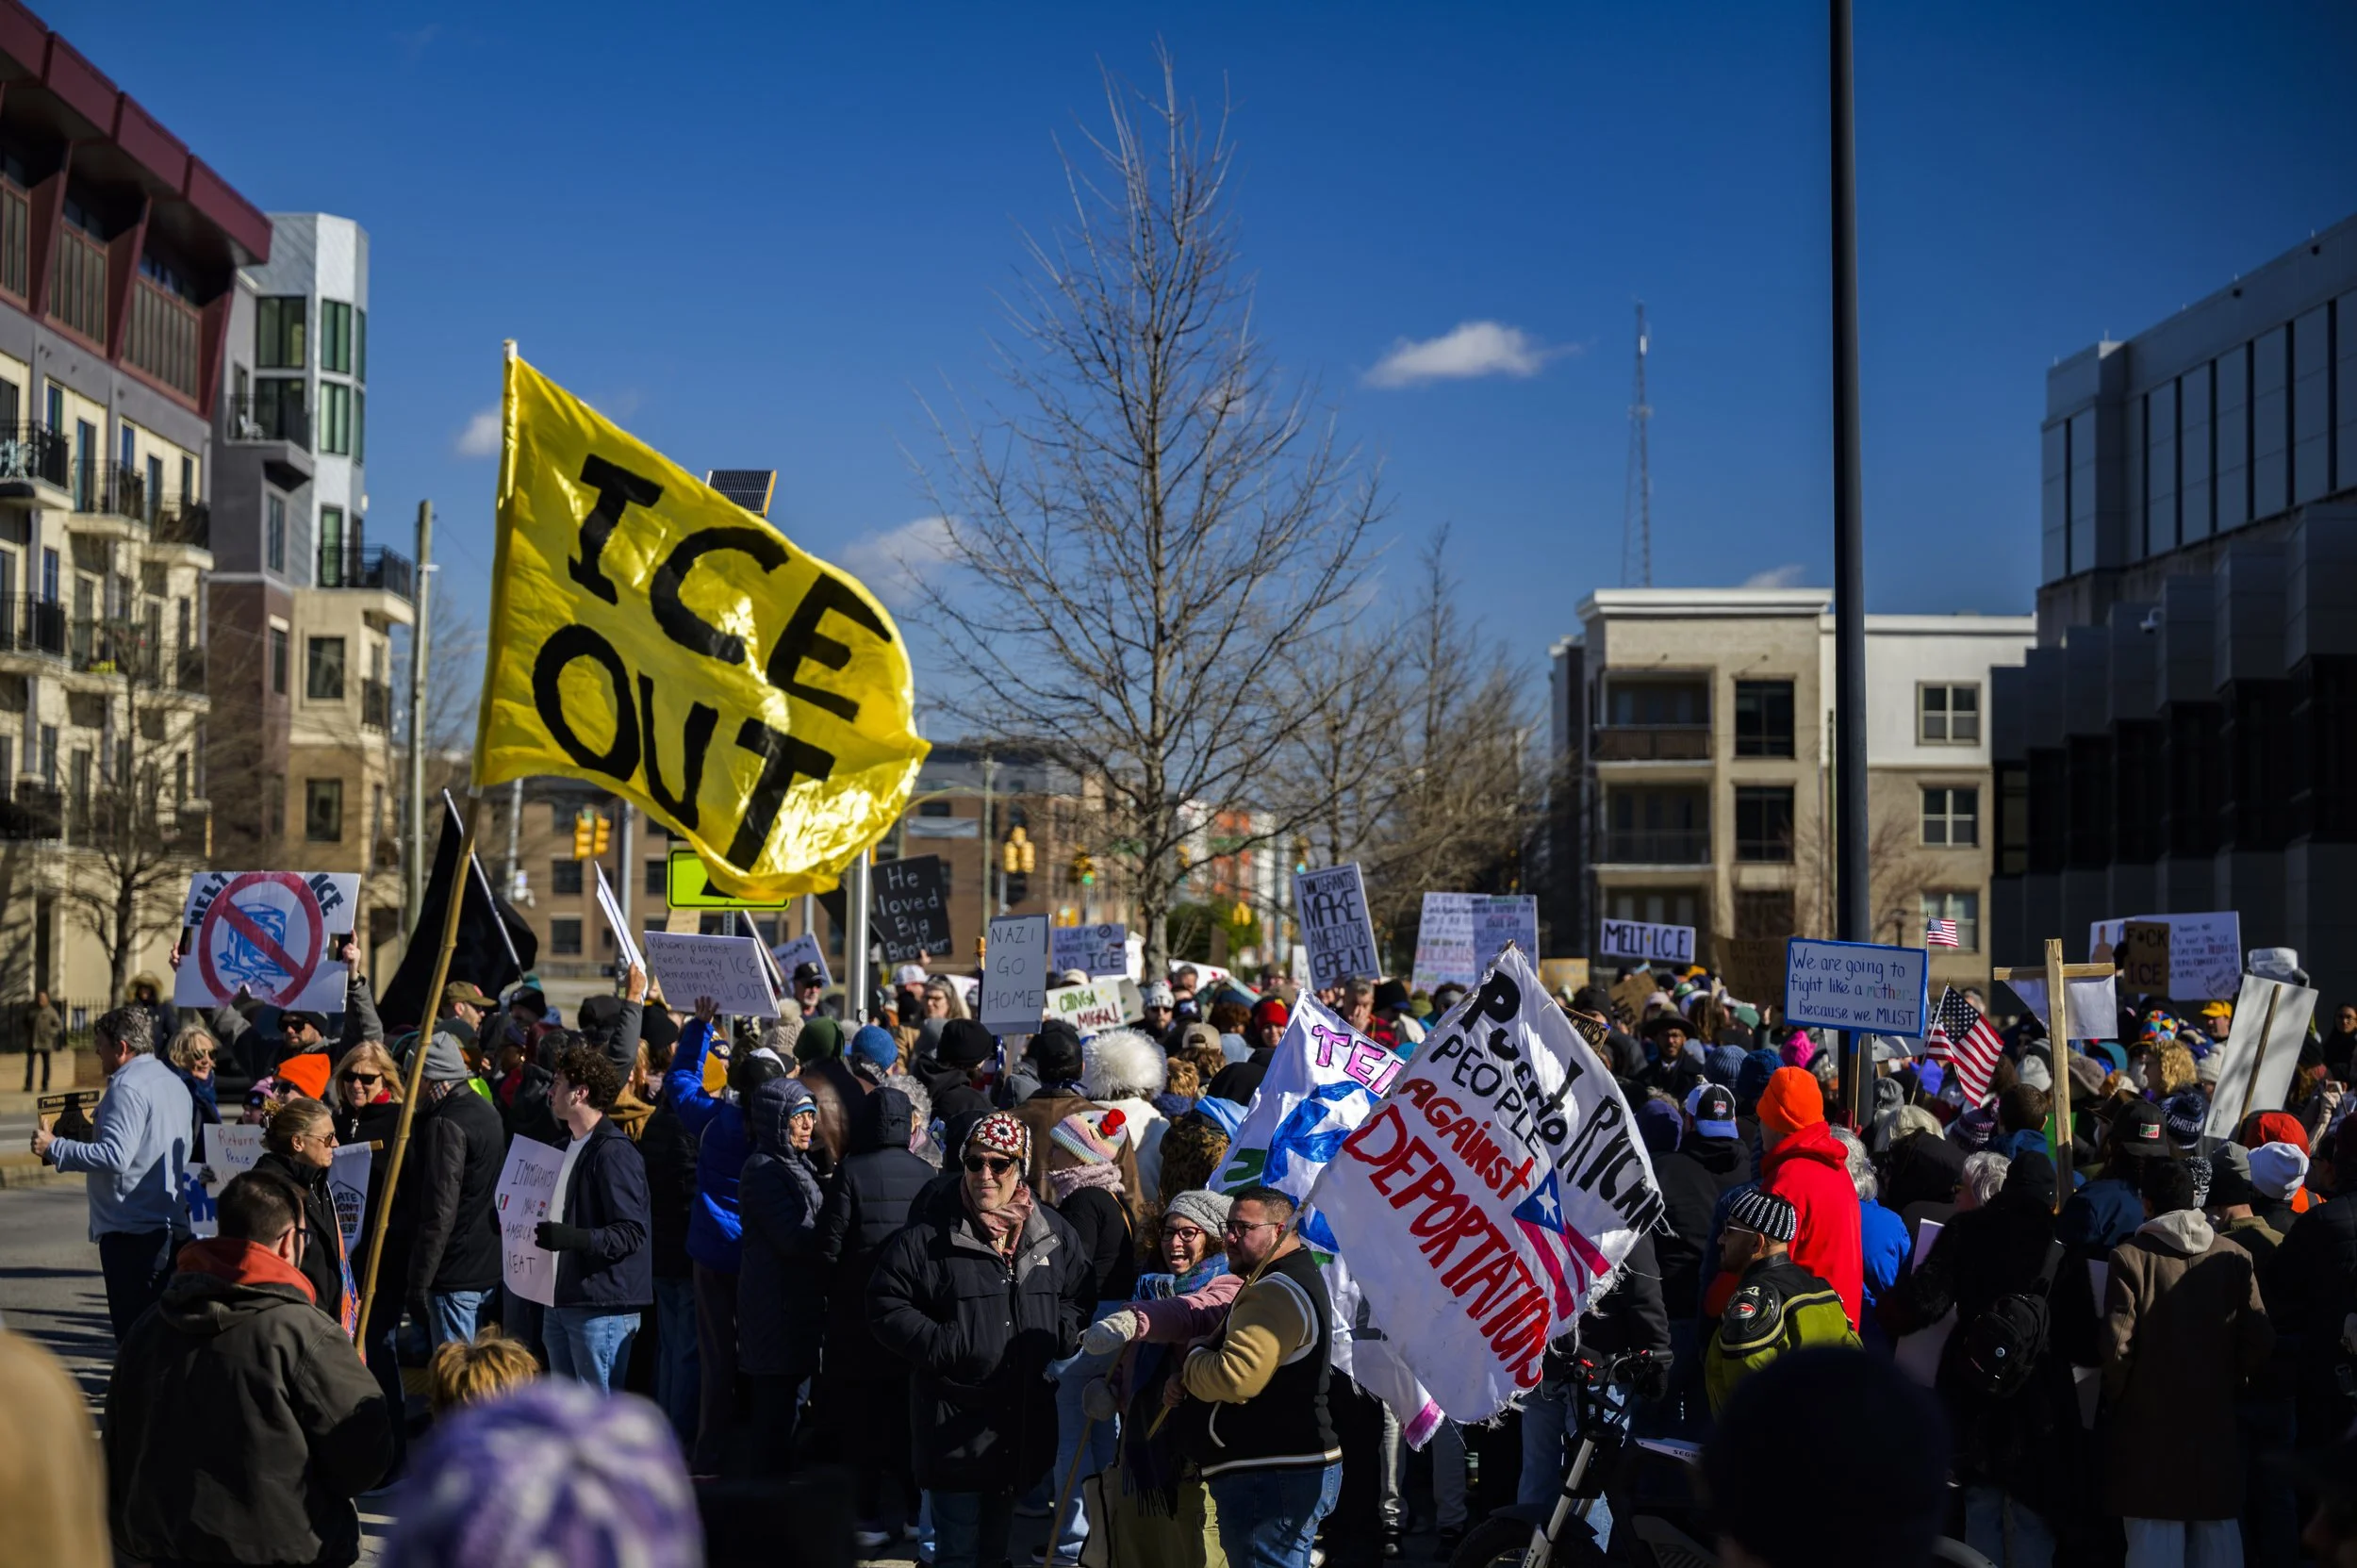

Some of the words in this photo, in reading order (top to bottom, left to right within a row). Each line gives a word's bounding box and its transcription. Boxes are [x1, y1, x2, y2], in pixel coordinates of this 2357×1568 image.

[569, 453, 892, 723] ICE
[533, 622, 836, 871] OUT
[887, 865, 919, 890] He
[190, 872, 229, 926] MELT
[308, 873, 344, 917] ICE
[879, 887, 939, 916] loved
[1302, 888, 1362, 930] MAKE
[895, 916, 931, 940] Big
[991, 926, 1034, 946] NAZI
[1310, 922, 1368, 952] AMERICA
[1604, 923, 1646, 953] MELT
[1653, 927, 1692, 959] I.C.E.
[690, 942, 732, 955] protest
[886, 936, 949, 963] Brother
[1086, 951, 1122, 972] ICE
[728, 957, 761, 979] ICE
[997, 956, 1026, 977] GO
[1313, 946, 1369, 979] GREAT
[1792, 947, 1816, 970] We
[1821, 958, 1842, 972] are
[1845, 958, 1884, 984] going
[1889, 962, 1905, 979] to
[2129, 961, 2163, 986] ICE
[736, 982, 767, 1001] OUT
[987, 990, 1042, 1011] HOME
[1790, 973, 1822, 1001] fight
[1829, 977, 1850, 995] like
[1854, 984, 1863, 996] a
[1799, 1000, 1848, 1019] because
[1854, 1009, 1871, 1022] we
[1876, 1008, 1916, 1027] MUST
[1429, 1033, 1540, 1160] PEOPLE
[218, 1128, 255, 1147] Return
[225, 1147, 251, 1164] Peace
